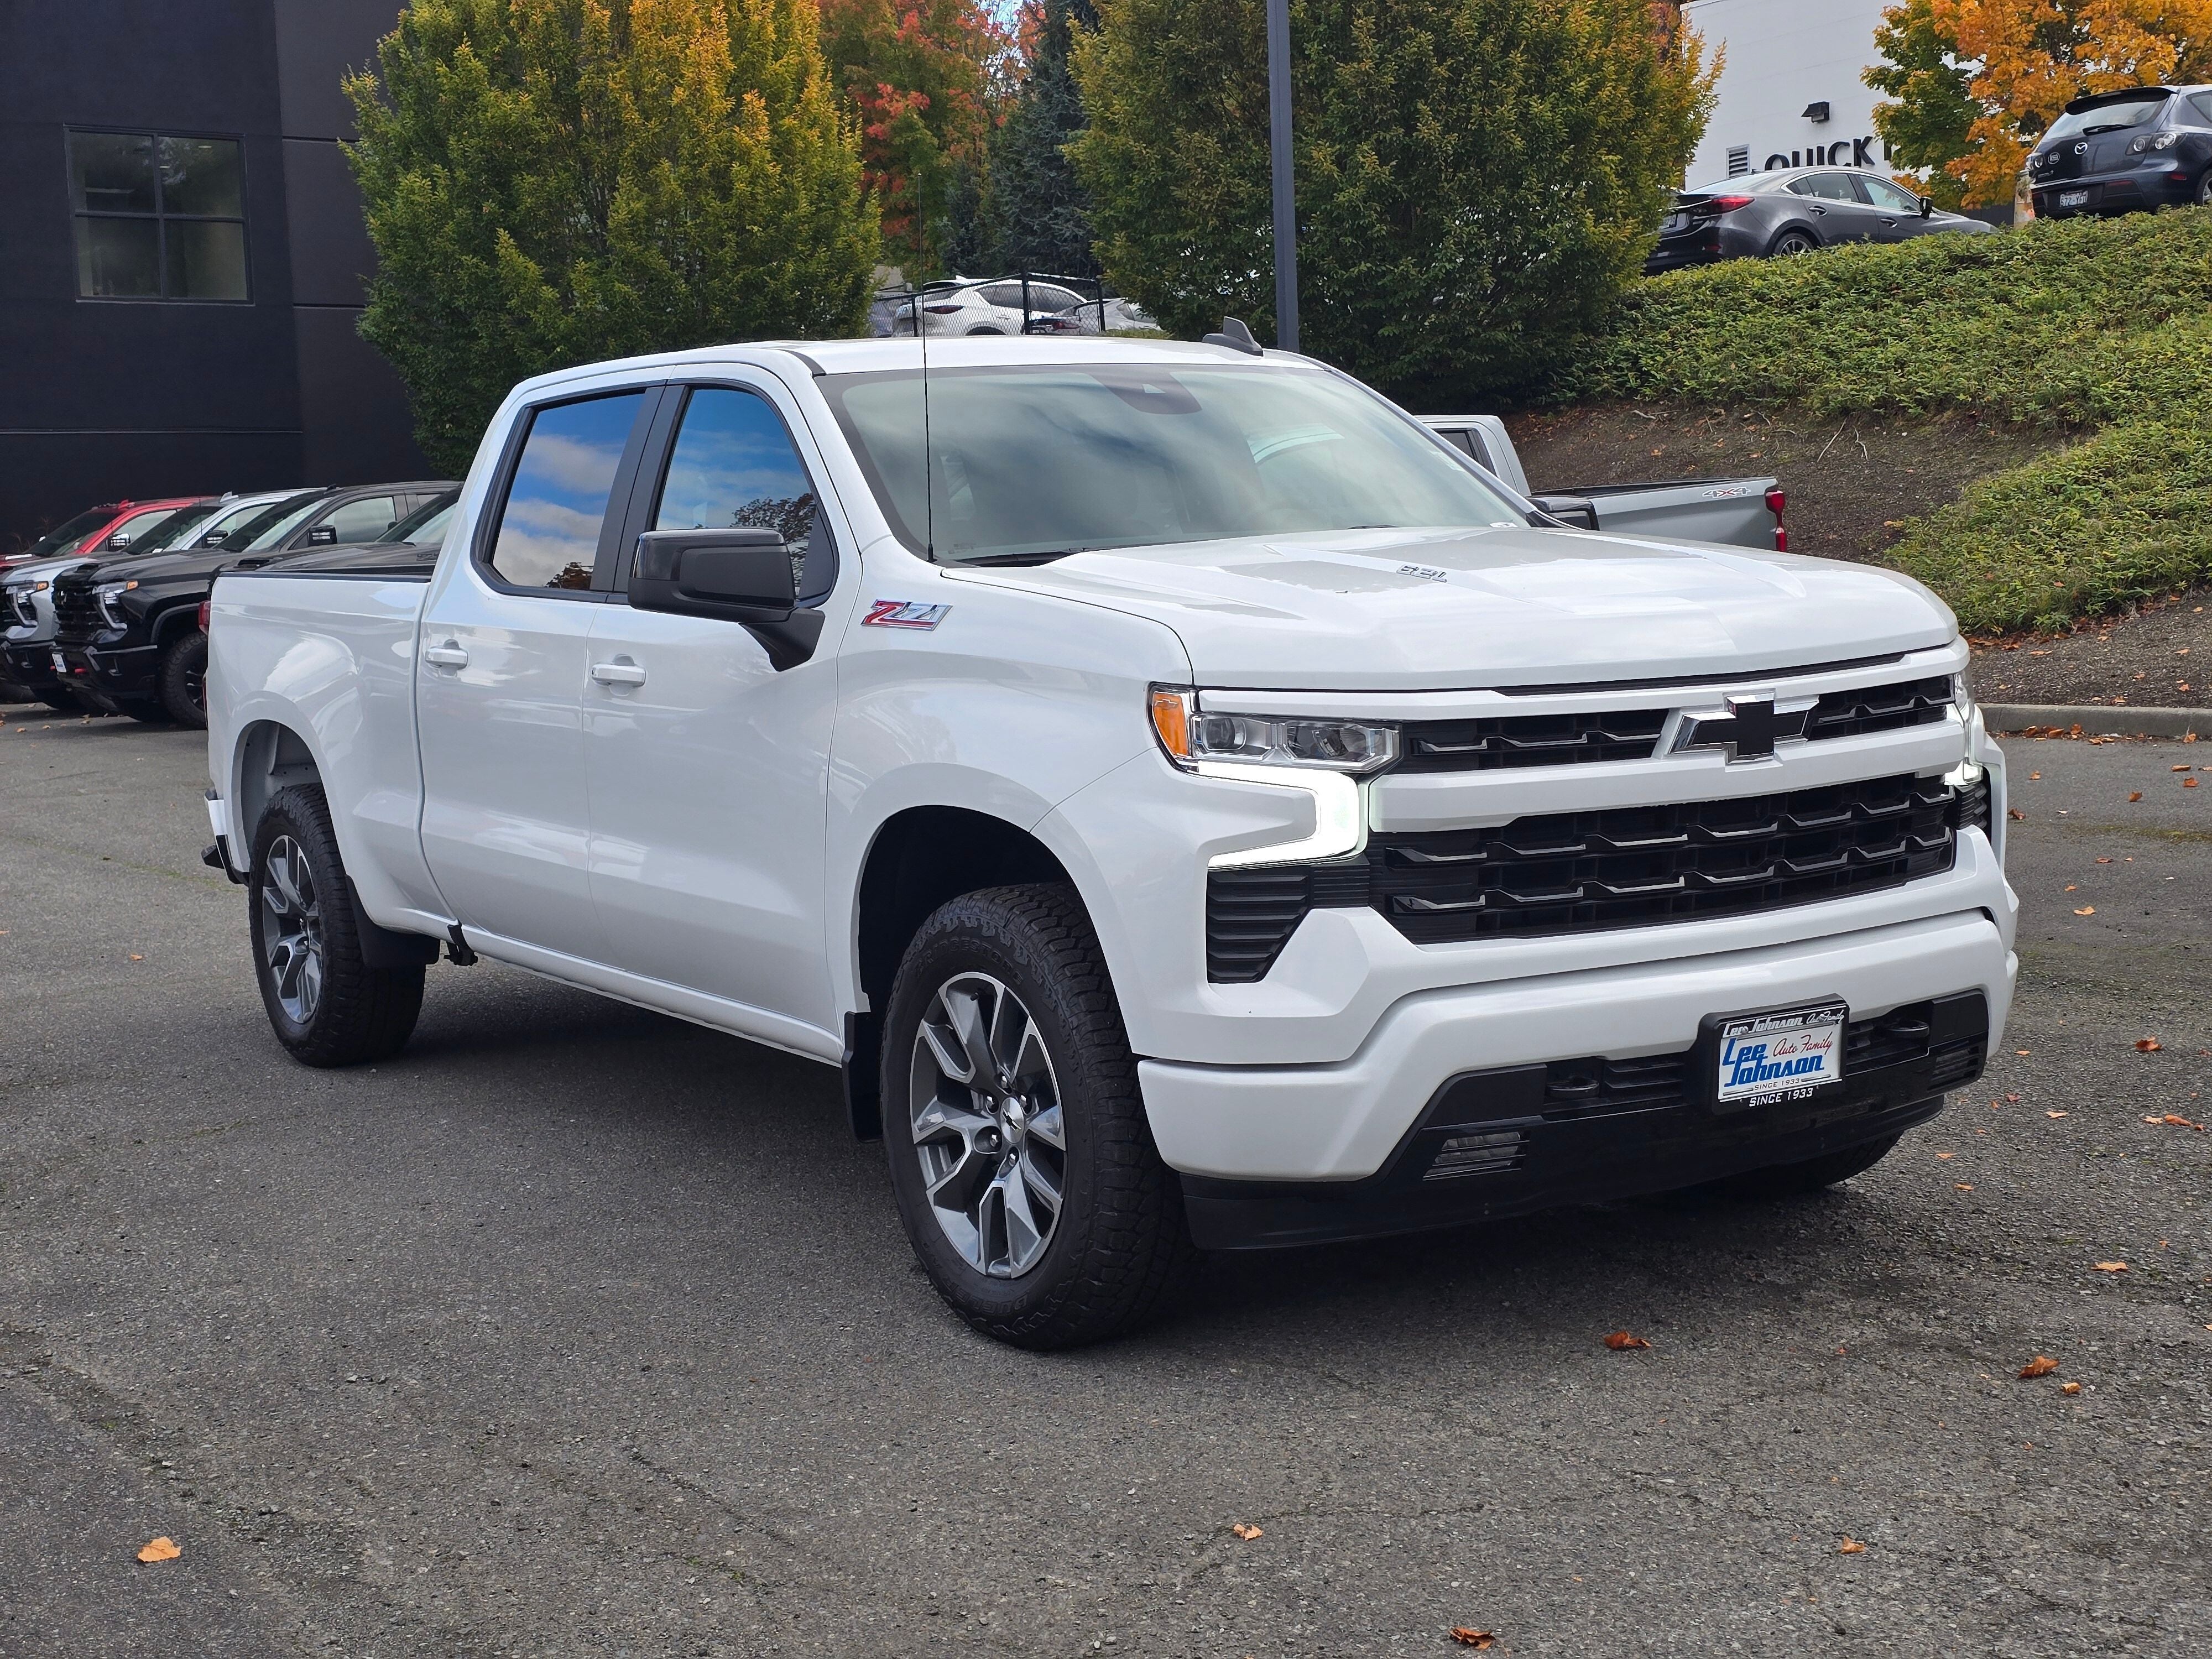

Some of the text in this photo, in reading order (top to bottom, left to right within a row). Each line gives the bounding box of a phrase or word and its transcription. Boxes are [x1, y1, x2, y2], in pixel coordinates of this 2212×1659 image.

[860, 599, 953, 631] Z71
[1748, 1016, 1803, 1034] Johnson
[1721, 1037, 1768, 1066] Lee
[1773, 1031, 1833, 1057] Auto Family
[1724, 1053, 1825, 1088] Johnson
[1749, 1087, 1813, 1107] SINCE 1933
[1754, 1078, 1800, 1090] SINCE 1933
